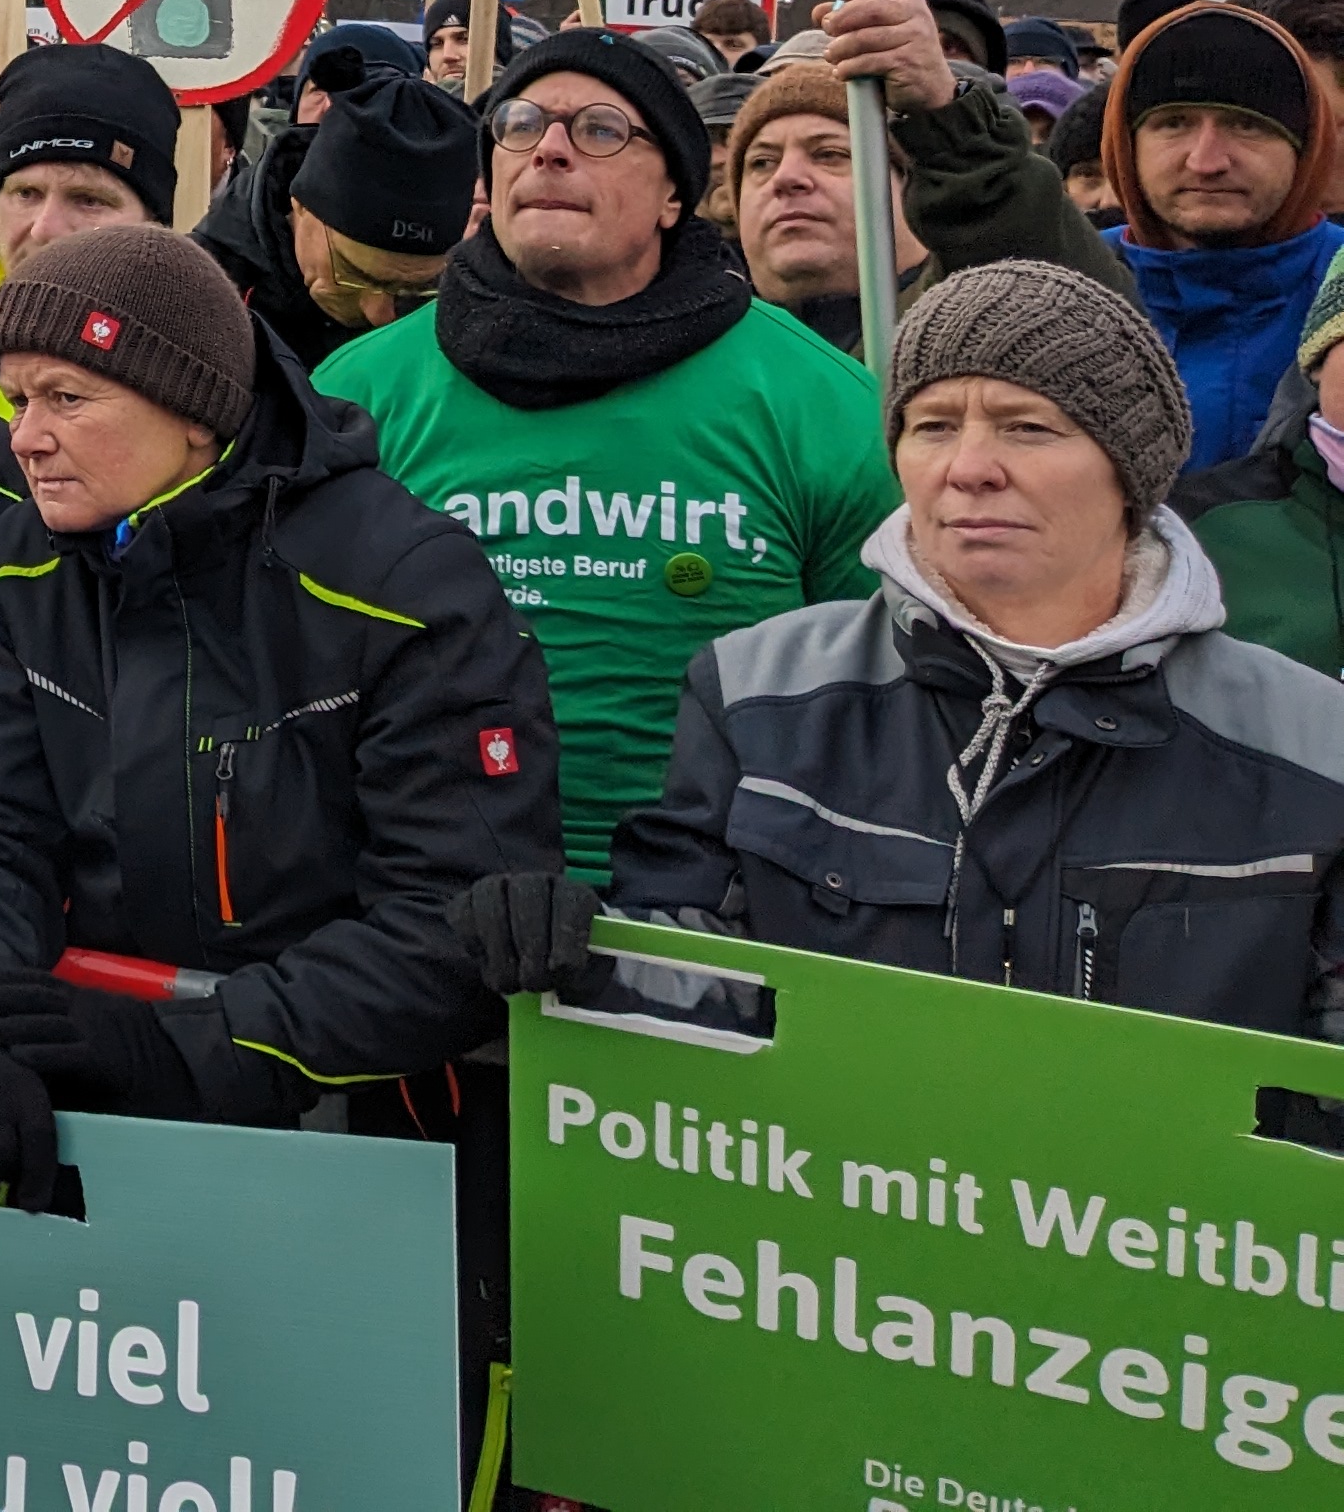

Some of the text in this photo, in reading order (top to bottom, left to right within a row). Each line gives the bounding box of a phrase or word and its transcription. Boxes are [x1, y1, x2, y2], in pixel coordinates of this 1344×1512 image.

[9, 138, 95, 159] UNIMOG
[443, 475, 768, 565] andwirt,
[504, 584, 549, 607] rde.
[573, 554, 647, 580] Beruf
[547, 1081, 814, 1200] Politik
[842, 1158, 985, 1236] mit
[15, 1288, 210, 1413] viel
[618, 1214, 1344, 1473] Fehlanzeige
[865, 1457, 925, 1498] Die
